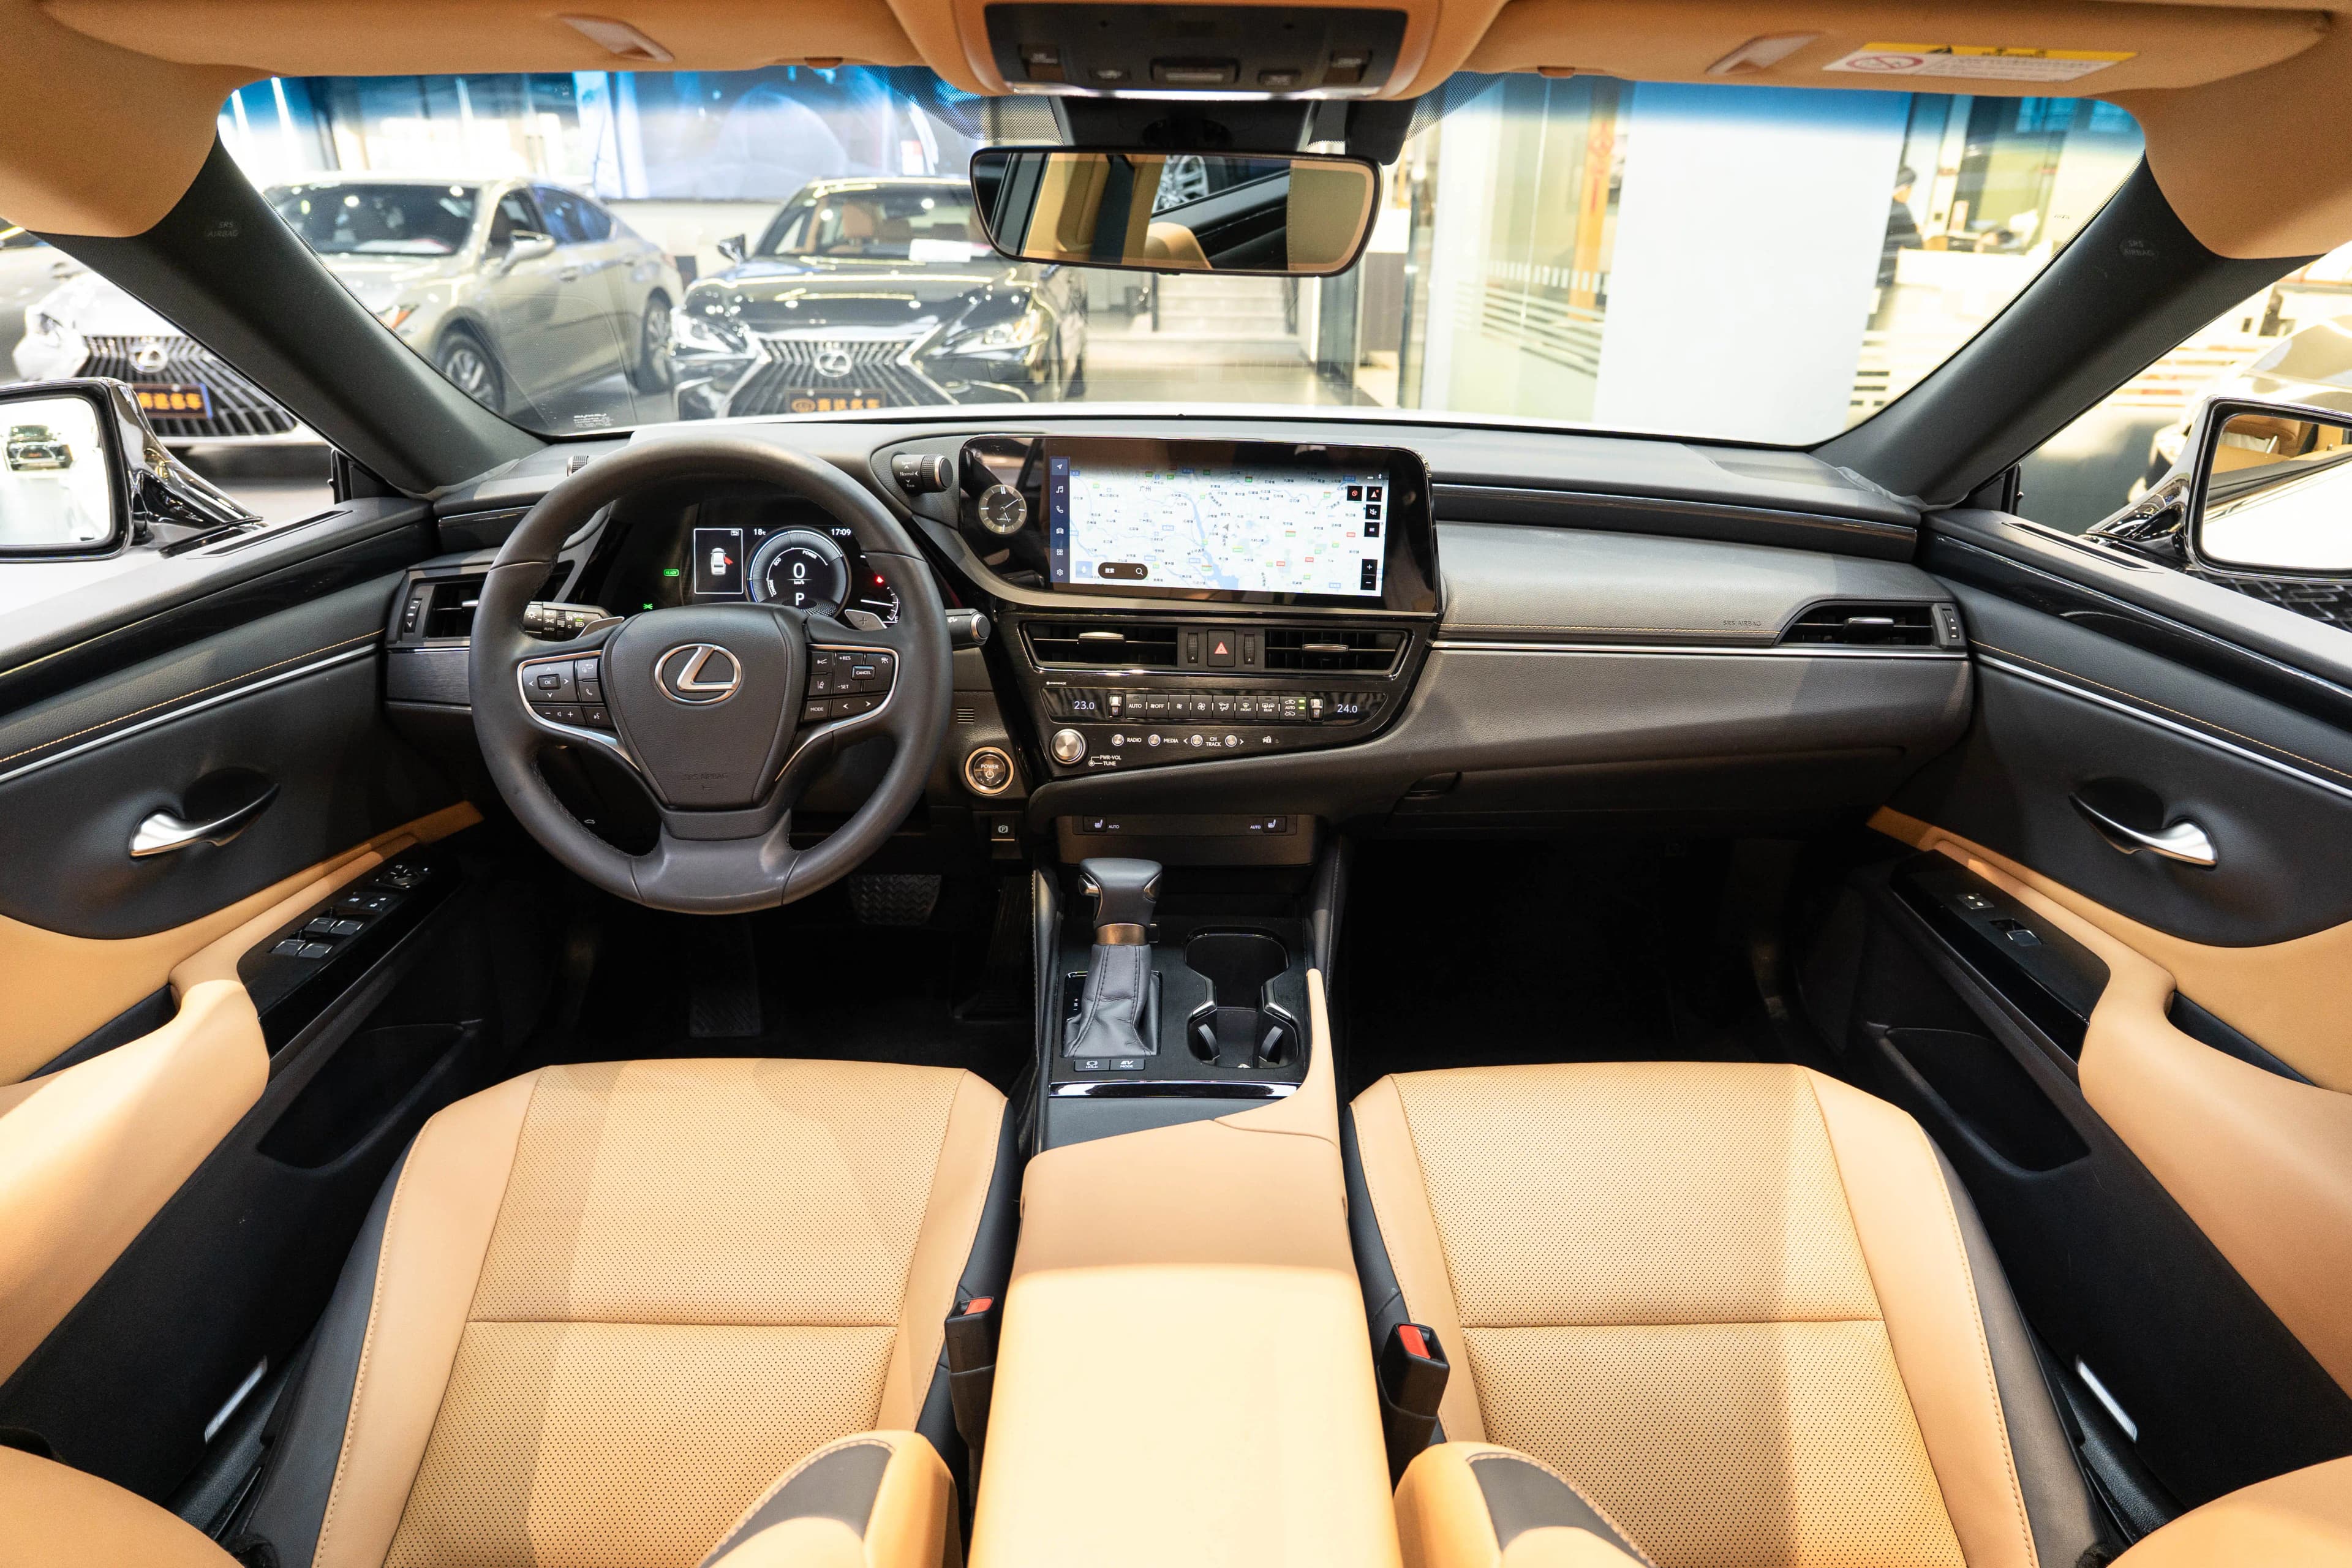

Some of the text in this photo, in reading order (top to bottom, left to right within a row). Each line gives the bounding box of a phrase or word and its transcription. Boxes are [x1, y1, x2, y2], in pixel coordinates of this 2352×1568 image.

[802, 550, 818, 559] POWER
[793, 562, 805, 579] 0
[796, 592, 805, 606] P
[1074, 701, 1095, 710] 23.0
[1337, 704, 1358, 713] 24.0
